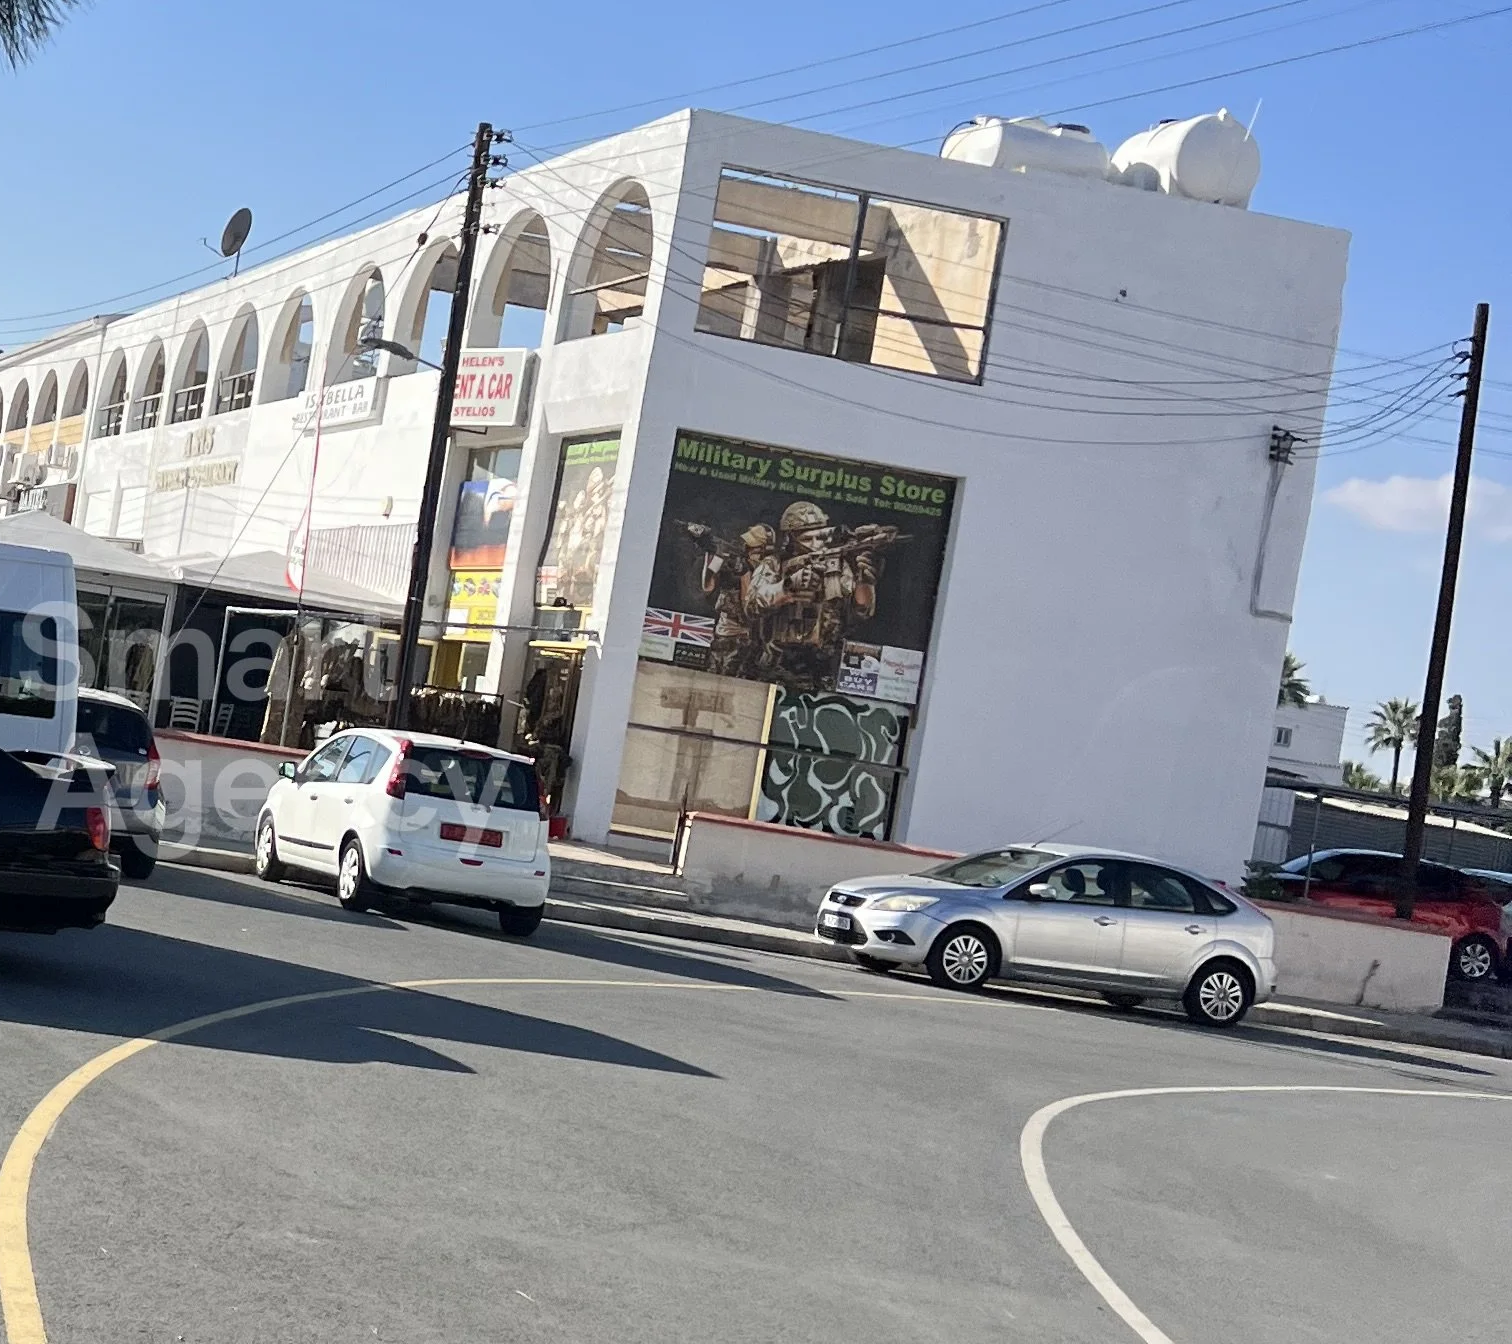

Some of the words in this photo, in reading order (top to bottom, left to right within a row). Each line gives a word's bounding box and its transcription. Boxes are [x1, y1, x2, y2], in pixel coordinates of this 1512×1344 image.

[462, 356, 505, 367] HELEN'S
[305, 384, 364, 410] ISBELLA
[454, 374, 477, 399] ENT
[476, 374, 486, 399] A
[487, 373, 513, 399] CAR
[454, 406, 495, 417] STELIOS
[677, 437, 772, 479] Military
[778, 458, 872, 492] Surplus
[879, 475, 946, 504] Store
